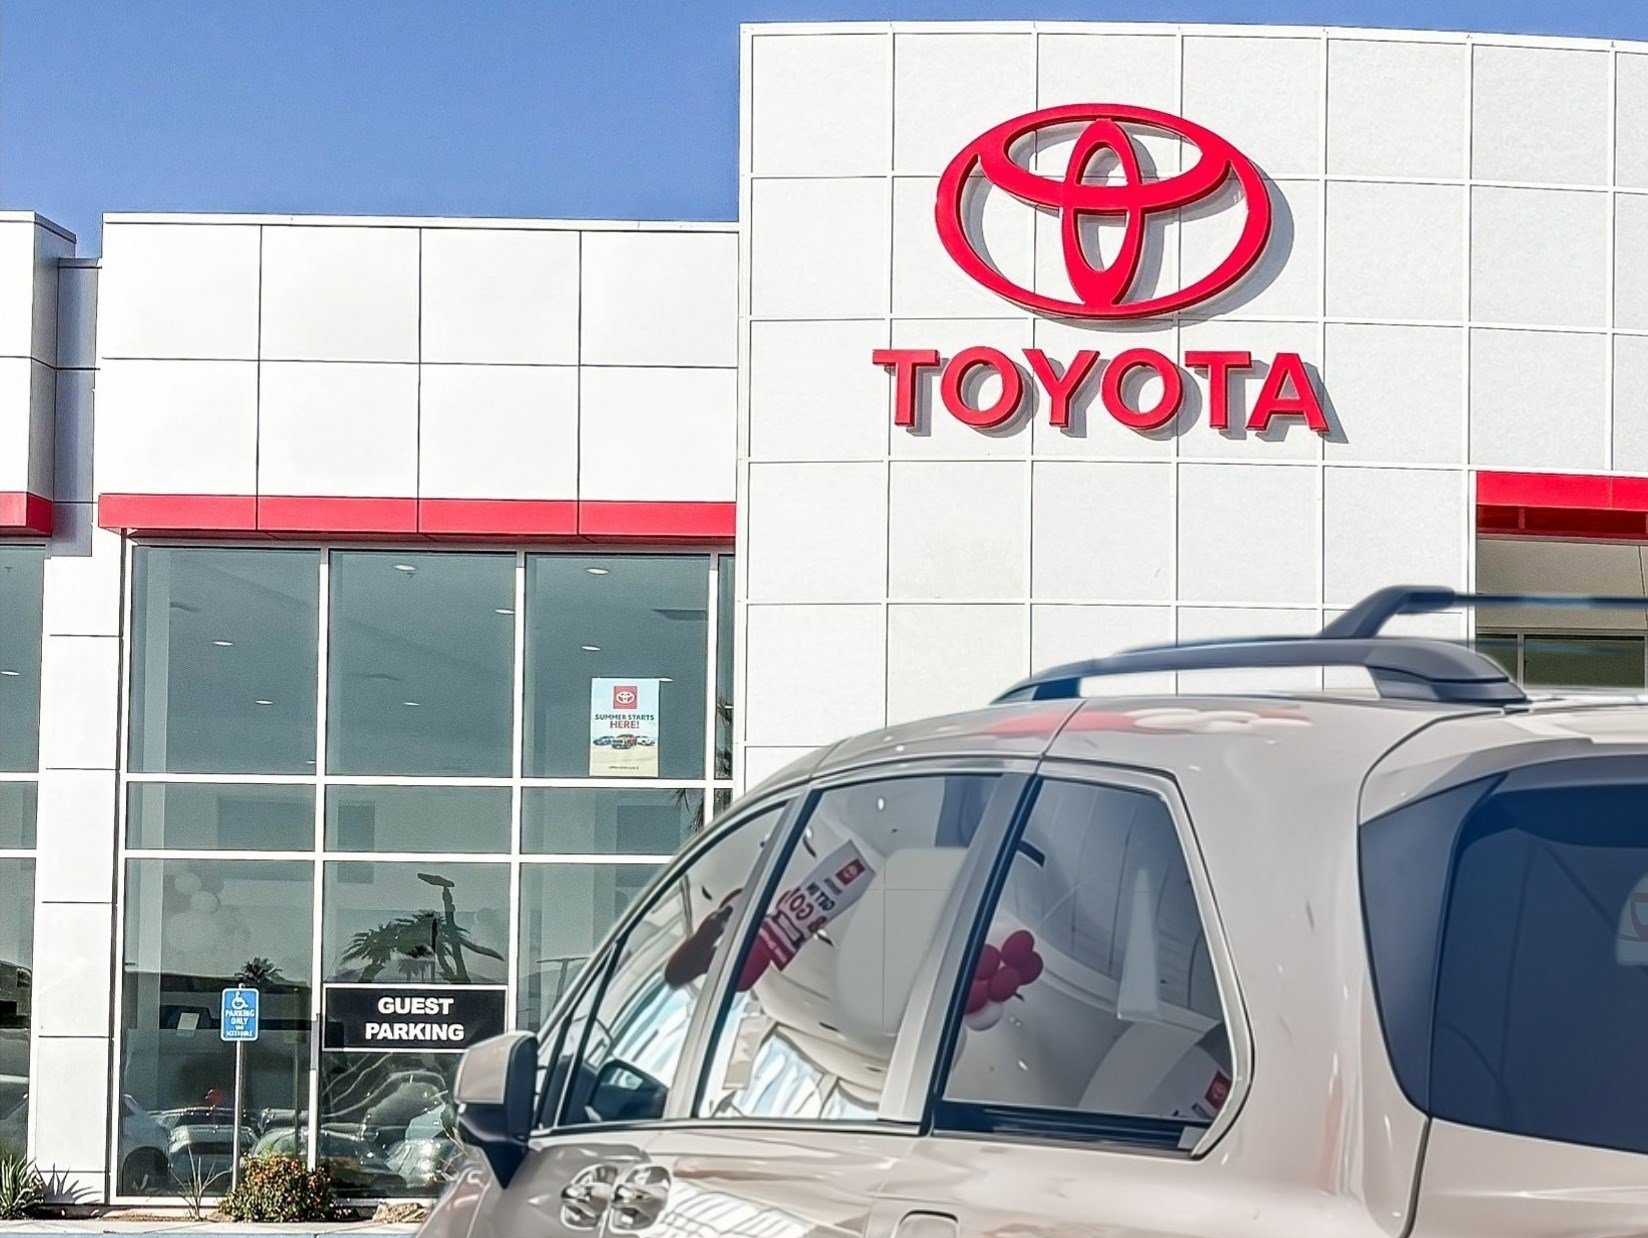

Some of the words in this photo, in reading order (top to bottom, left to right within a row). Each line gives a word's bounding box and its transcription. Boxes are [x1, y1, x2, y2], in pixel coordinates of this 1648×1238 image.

[872, 345, 1330, 432] TOYOTA
[609, 720, 640, 729] HERE!
[377, 997, 454, 1015] GUEST
[365, 1022, 464, 1041] PARKING
